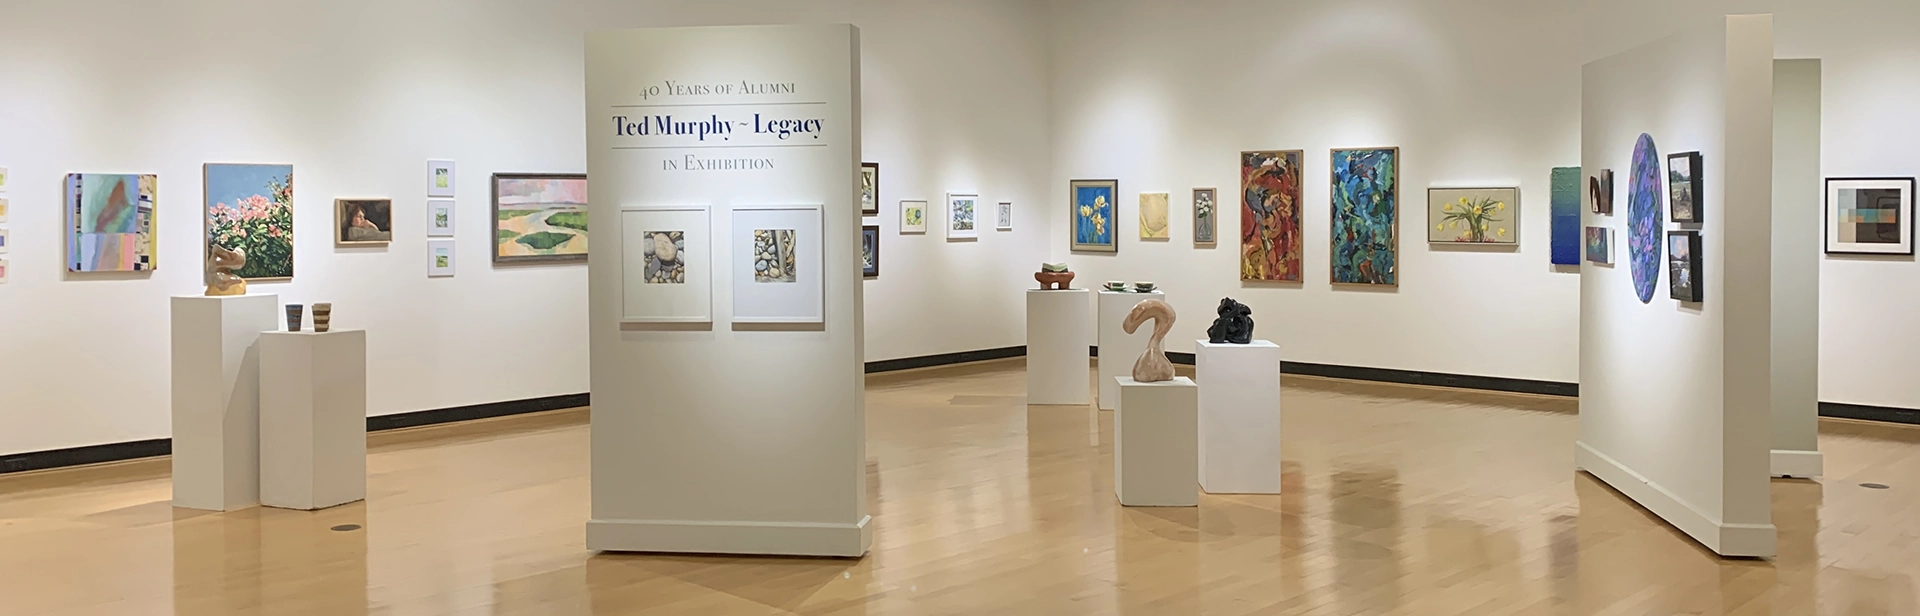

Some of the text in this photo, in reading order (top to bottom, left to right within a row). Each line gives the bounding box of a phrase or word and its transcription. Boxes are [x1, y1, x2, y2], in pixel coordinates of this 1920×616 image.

[639, 80, 795, 100] 40 YEARS OF ALUMNI
[612, 115, 649, 136] Ted
[654, 114, 735, 141] Murphy
[753, 113, 825, 140] Legacy
[663, 154, 774, 171] IN EXHIBITION
